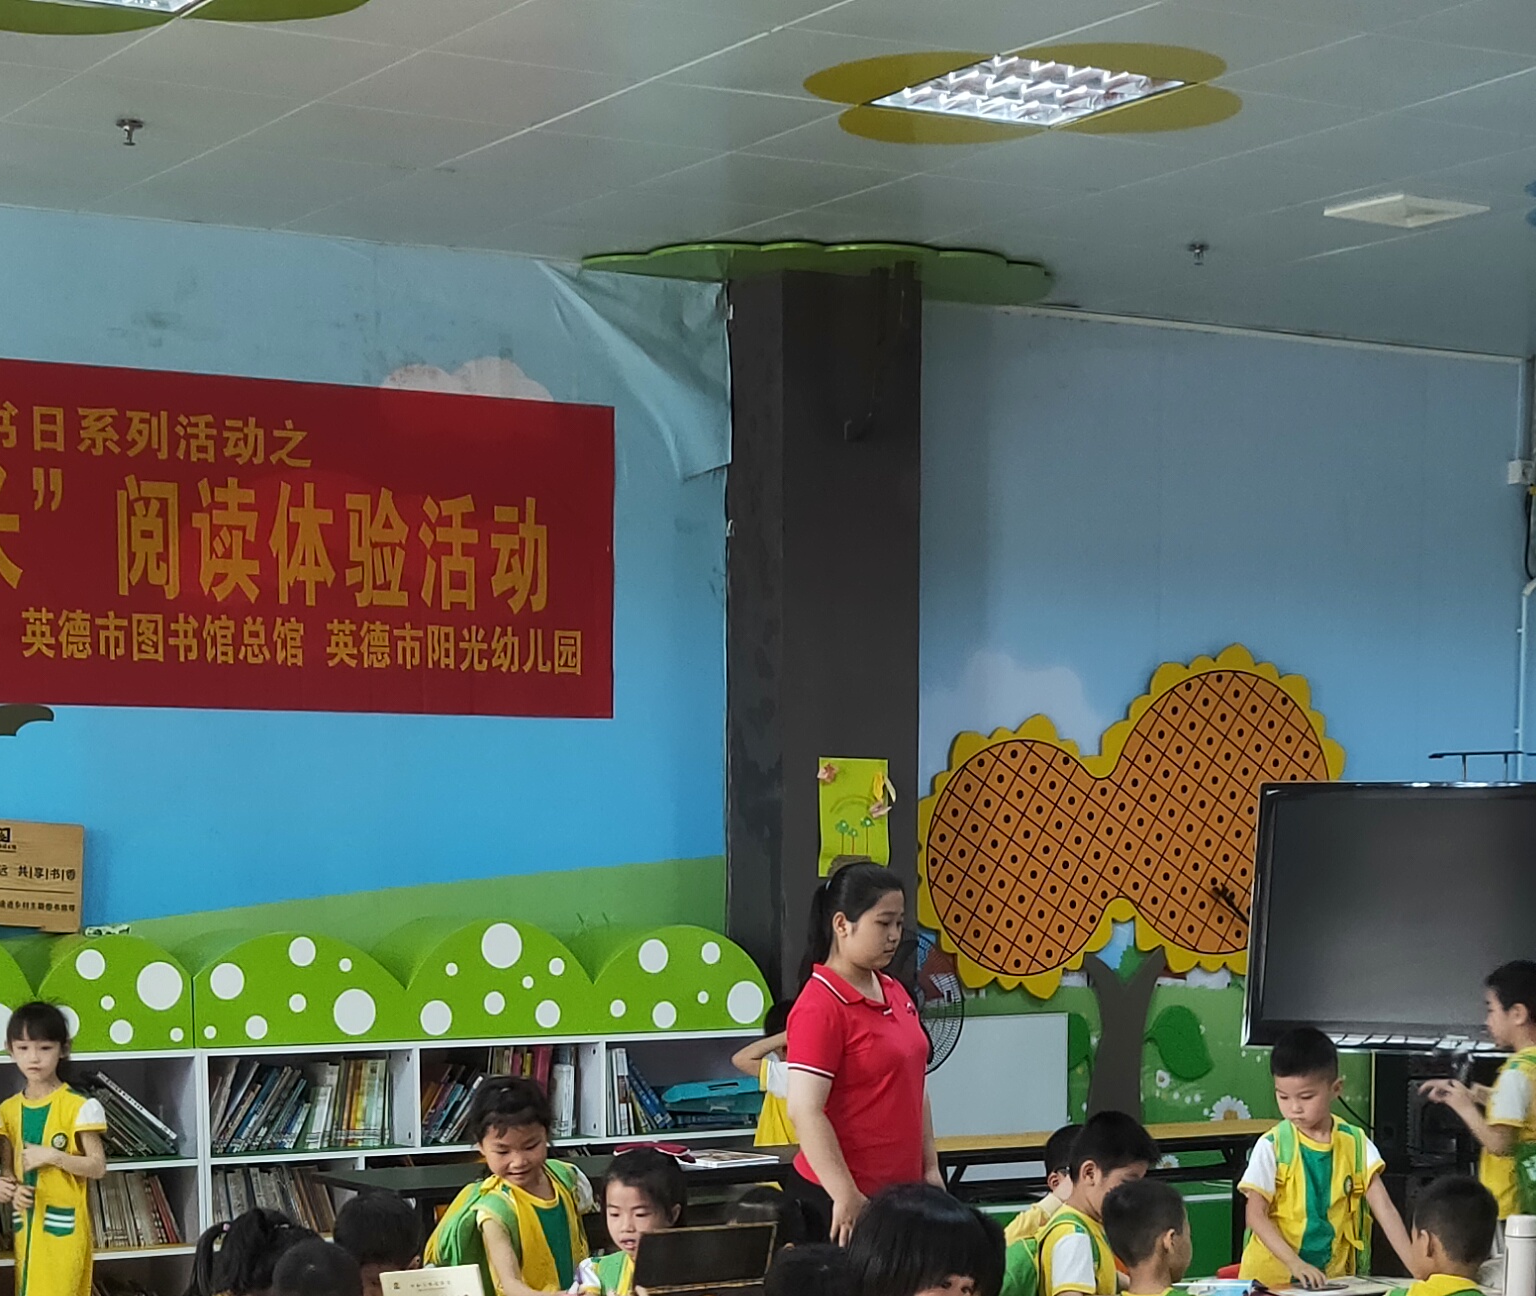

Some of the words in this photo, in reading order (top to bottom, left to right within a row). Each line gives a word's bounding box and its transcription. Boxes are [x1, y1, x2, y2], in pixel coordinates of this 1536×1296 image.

[326, 617, 583, 677] 英德市阳光幼儿园
